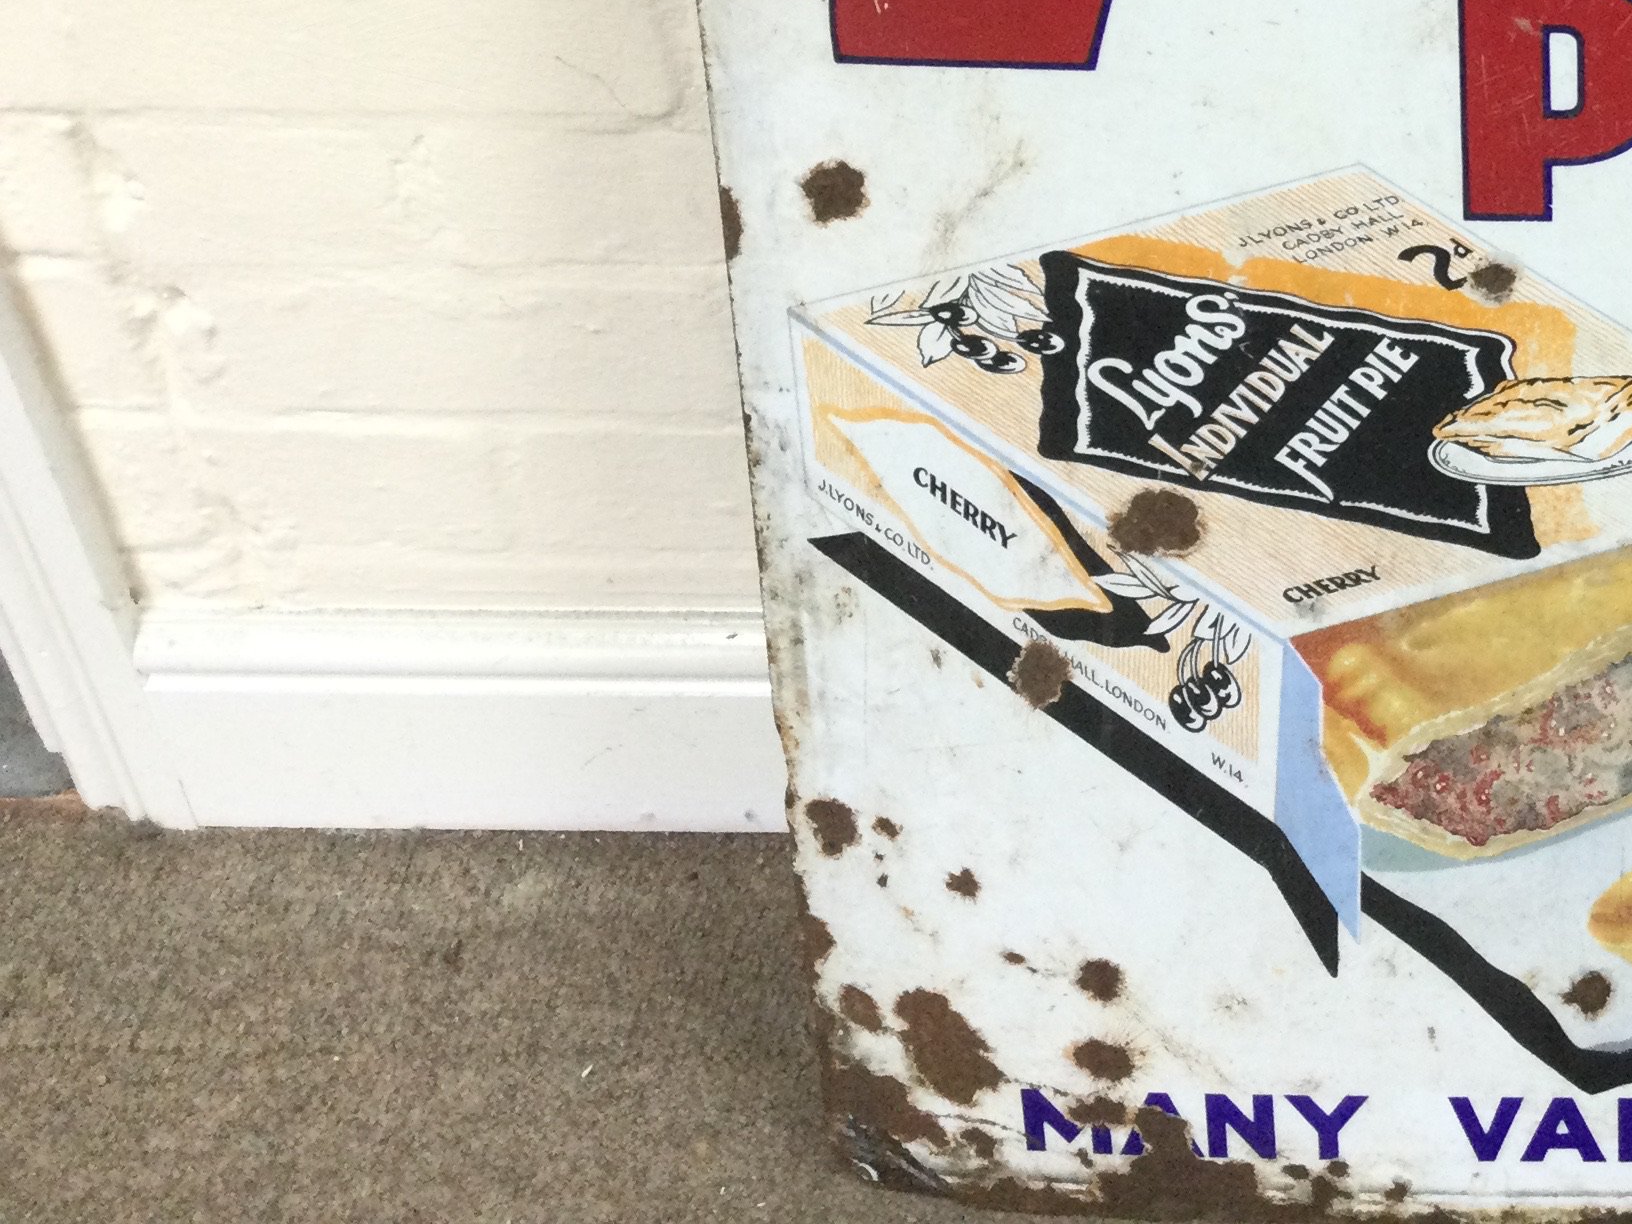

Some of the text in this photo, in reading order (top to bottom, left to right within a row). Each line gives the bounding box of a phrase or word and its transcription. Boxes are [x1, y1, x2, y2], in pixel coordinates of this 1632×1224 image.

[1281, 212, 1404, 251] CADBY HALL
[1397, 237, 1474, 292] 2d
[1147, 322, 1336, 481] INDIVIDUAL
[1273, 335, 1421, 505] FRUIT PIE
[912, 466, 1018, 550] CHERRY
[1282, 564, 1382, 603] CHERRY
